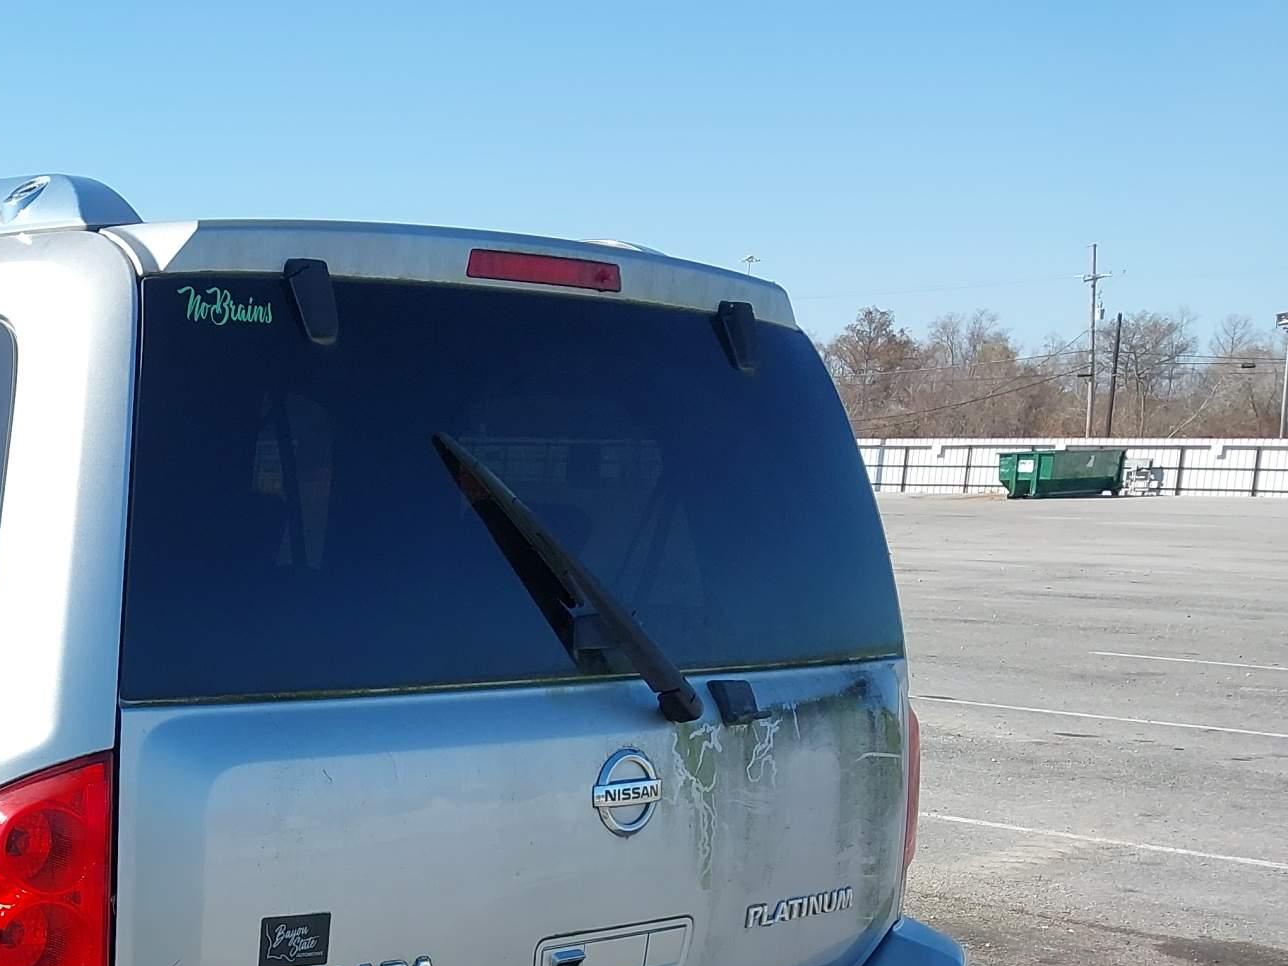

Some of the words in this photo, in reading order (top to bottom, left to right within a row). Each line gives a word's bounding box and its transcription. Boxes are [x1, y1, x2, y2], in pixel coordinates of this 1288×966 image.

[605, 784, 658, 802] NISSAN
[744, 886, 852, 928] PLATINUM
[273, 924, 309, 948] Bayou
[290, 936, 320, 957] State
